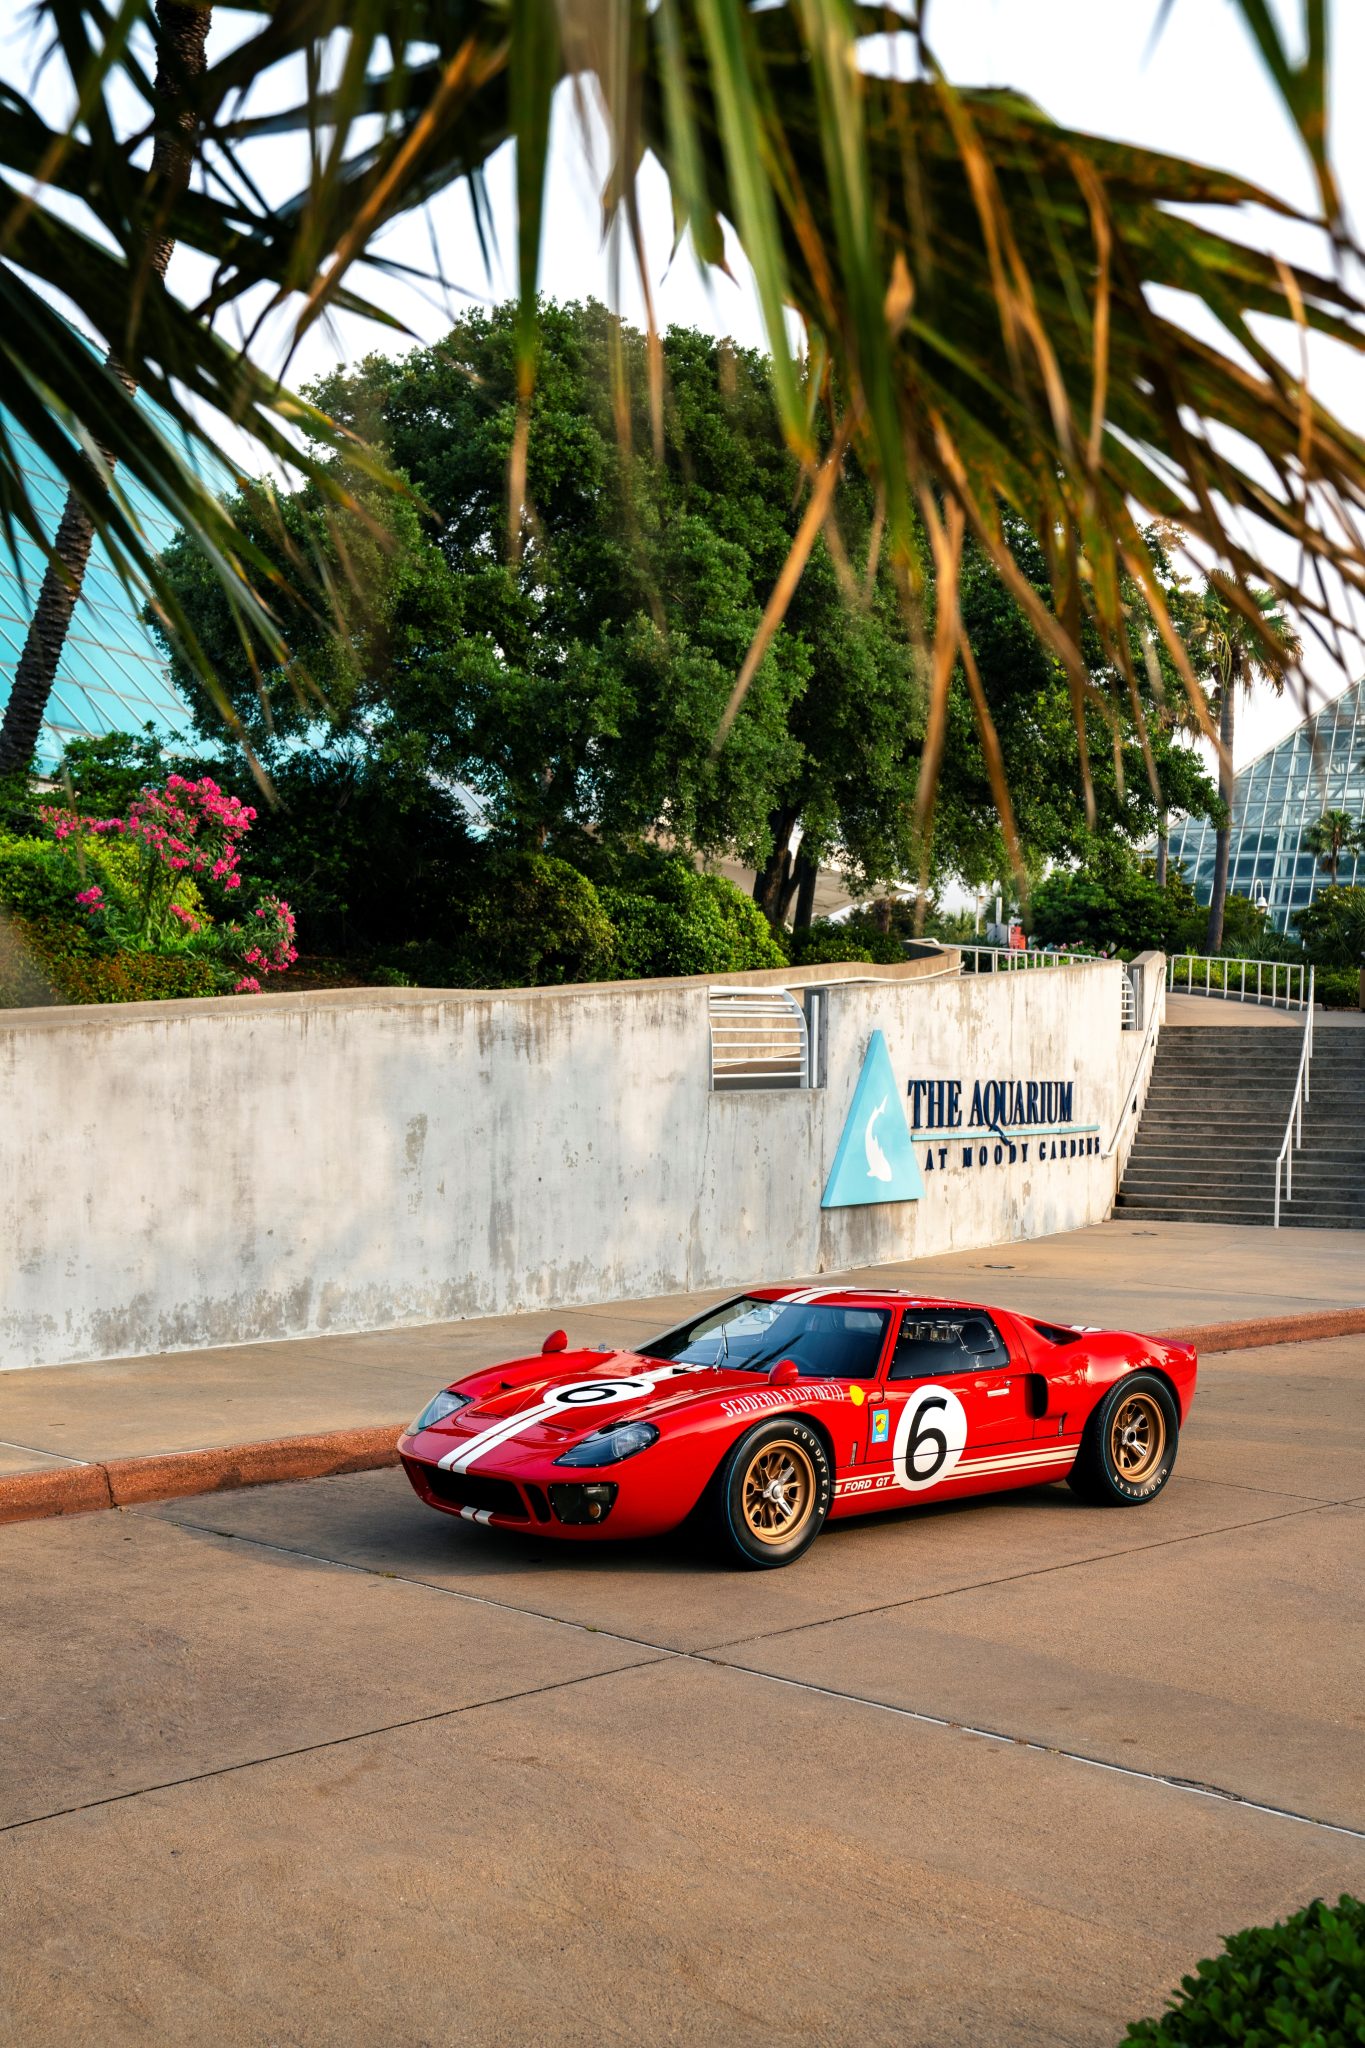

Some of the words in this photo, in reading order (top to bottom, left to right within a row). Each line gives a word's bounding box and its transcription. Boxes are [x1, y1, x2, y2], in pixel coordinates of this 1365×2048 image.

[907, 1079, 963, 1130] THE
[967, 1079, 1074, 1146] AQUARIUM
[924, 1147, 948, 1171] AT
[962, 1143, 1029, 1169] MOODY
[1039, 1136, 1100, 1161] GARDENS
[556, 1381, 645, 1404] 6
[720, 1390, 787, 1418] SCUDERIA
[781, 1384, 845, 1403] FILIPINETTI
[904, 1395, 949, 1483] 6
[793, 1427, 828, 1516] GOODYEAR
[843, 1479, 873, 1493] FORD
[875, 1476, 891, 1488] GT
